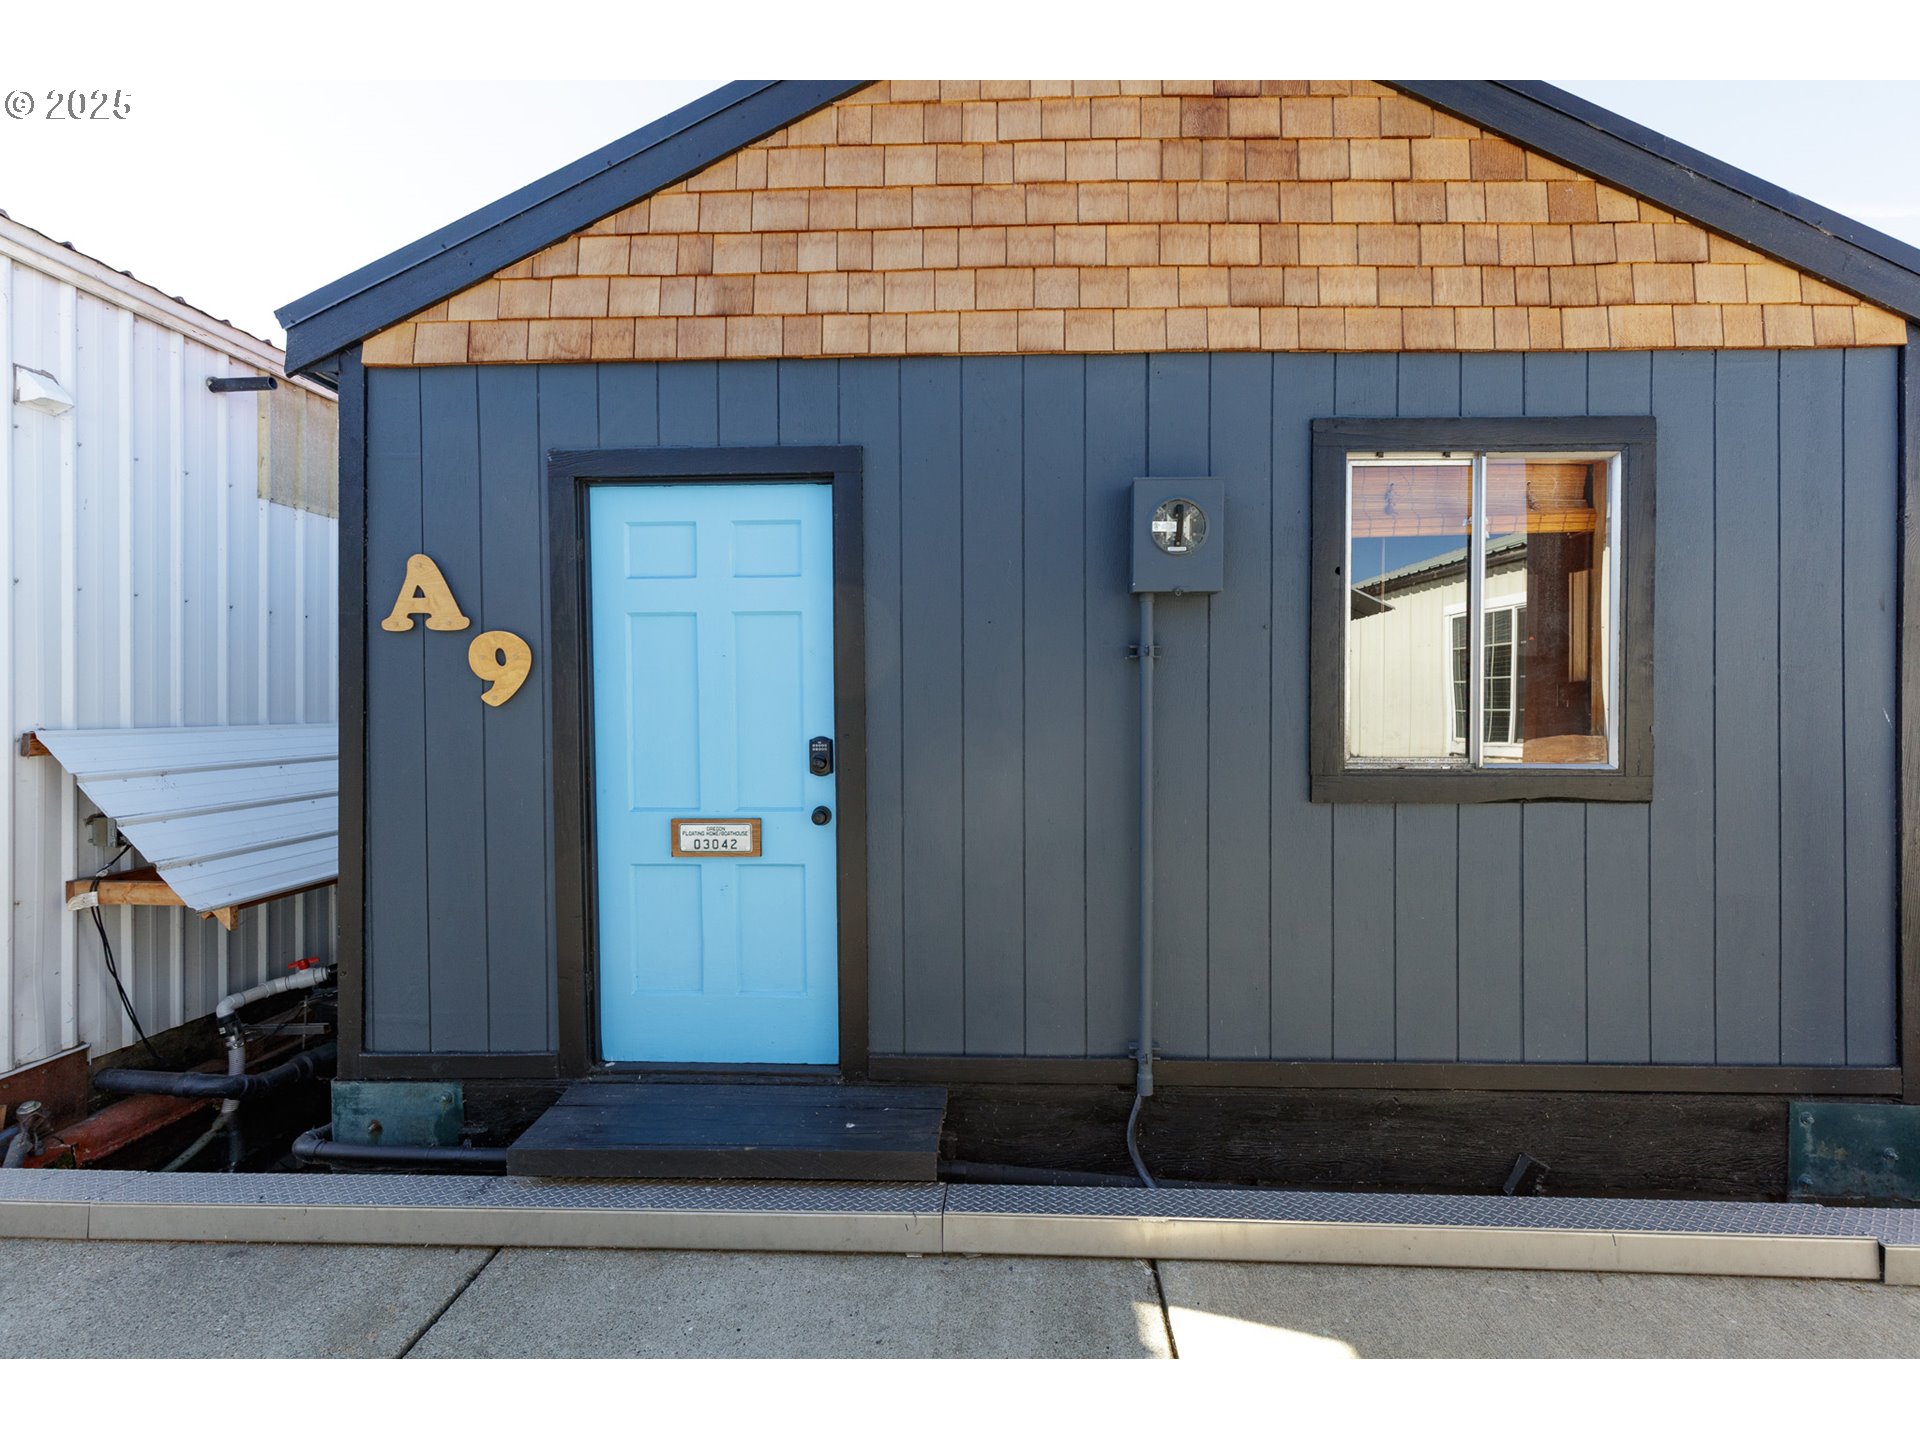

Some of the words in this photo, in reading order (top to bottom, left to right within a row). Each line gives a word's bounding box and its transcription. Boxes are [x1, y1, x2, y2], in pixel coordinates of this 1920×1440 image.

[381, 553, 470, 631] A
[468, 630, 532, 707] 9
[694, 839, 737, 849] 03042
